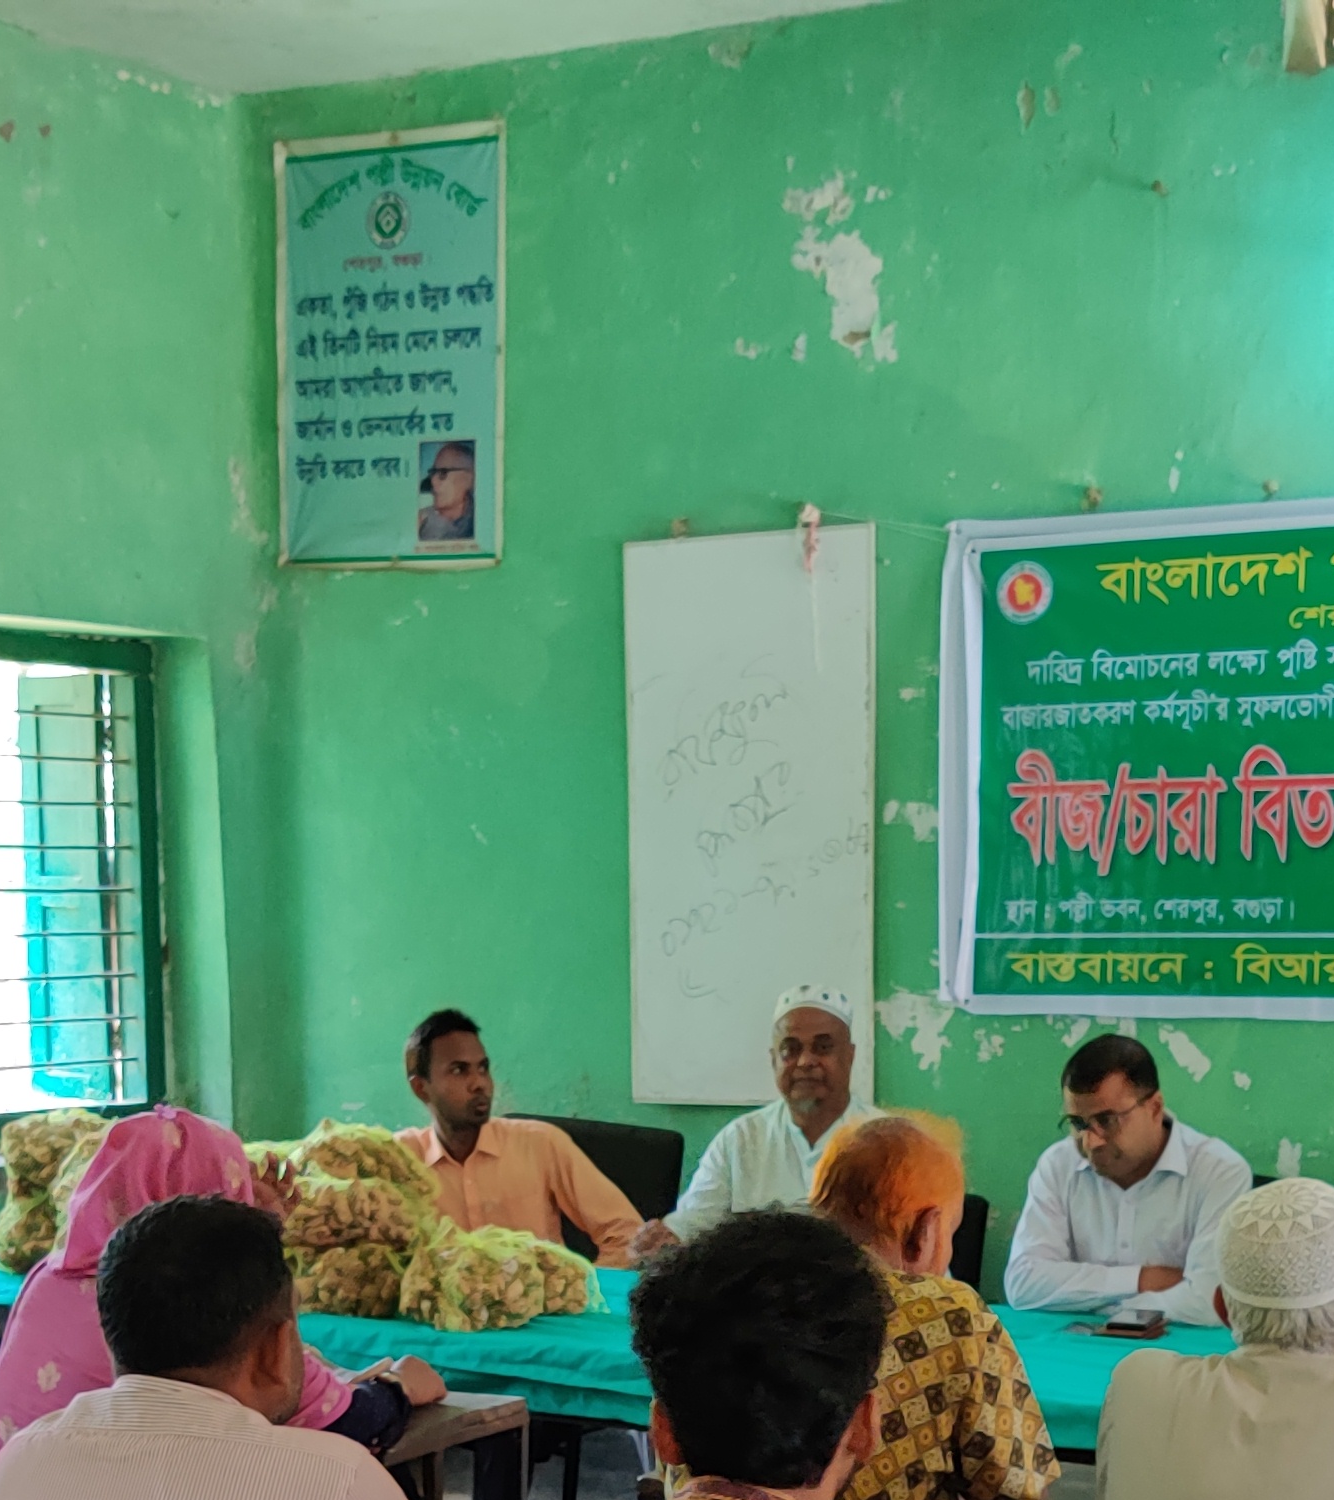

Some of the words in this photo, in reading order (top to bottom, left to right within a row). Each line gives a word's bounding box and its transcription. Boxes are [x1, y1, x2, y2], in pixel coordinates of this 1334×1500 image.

[1097, 547, 1313, 604] বাংলাদেশ
[1091, 648, 1200, 682] বিমোচনের
[1206, 649, 1269, 676] লক্ষ্যে
[1277, 637, 1318, 679] পুষ্টি
[1000, 700, 1136, 731] বাজারজাতকরণ
[1007, 748, 1228, 876] বীজ/চারা
[1099, 899, 1148, 925] ভবন,
[1154, 898, 1224, 926] শেরপুর,
[1006, 950, 1188, 984] বাস্তবায়নে
